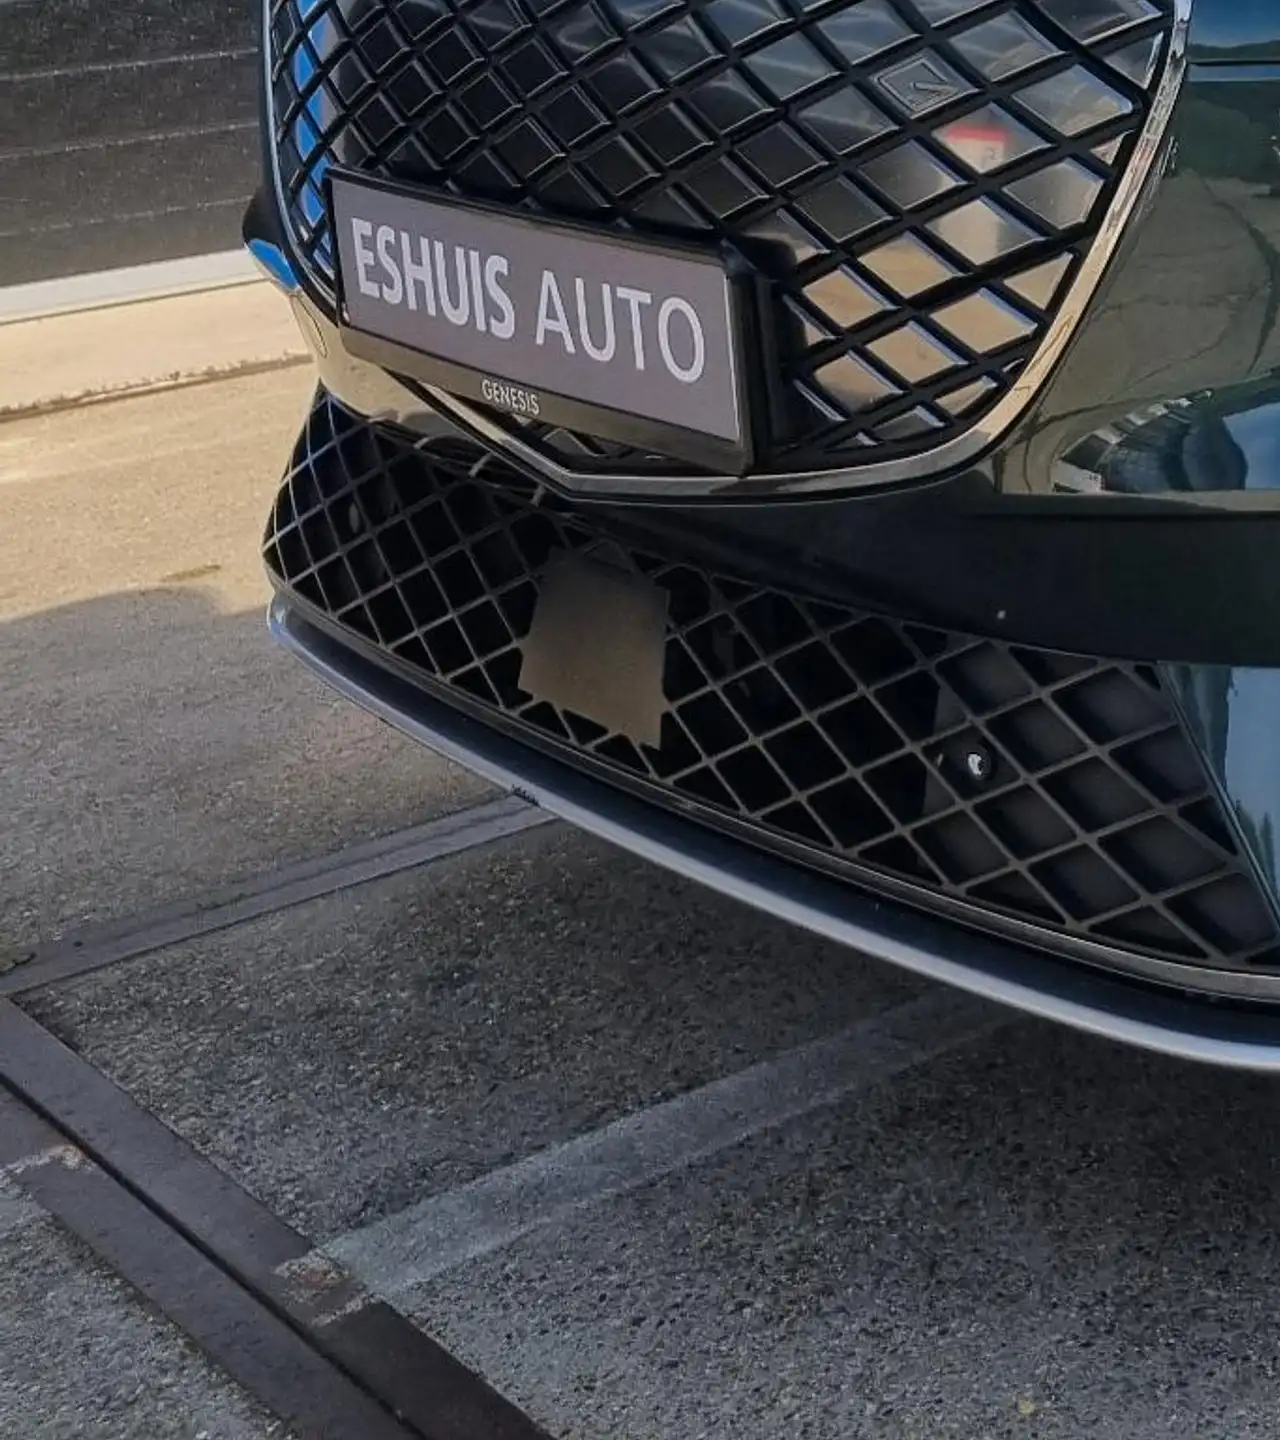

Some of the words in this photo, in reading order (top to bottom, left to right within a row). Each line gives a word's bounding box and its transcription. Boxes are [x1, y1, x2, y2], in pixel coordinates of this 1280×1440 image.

[351, 217, 516, 340] ESHUIS
[536, 269, 705, 383] AUTO
[481, 379, 540, 416] GENESIS
